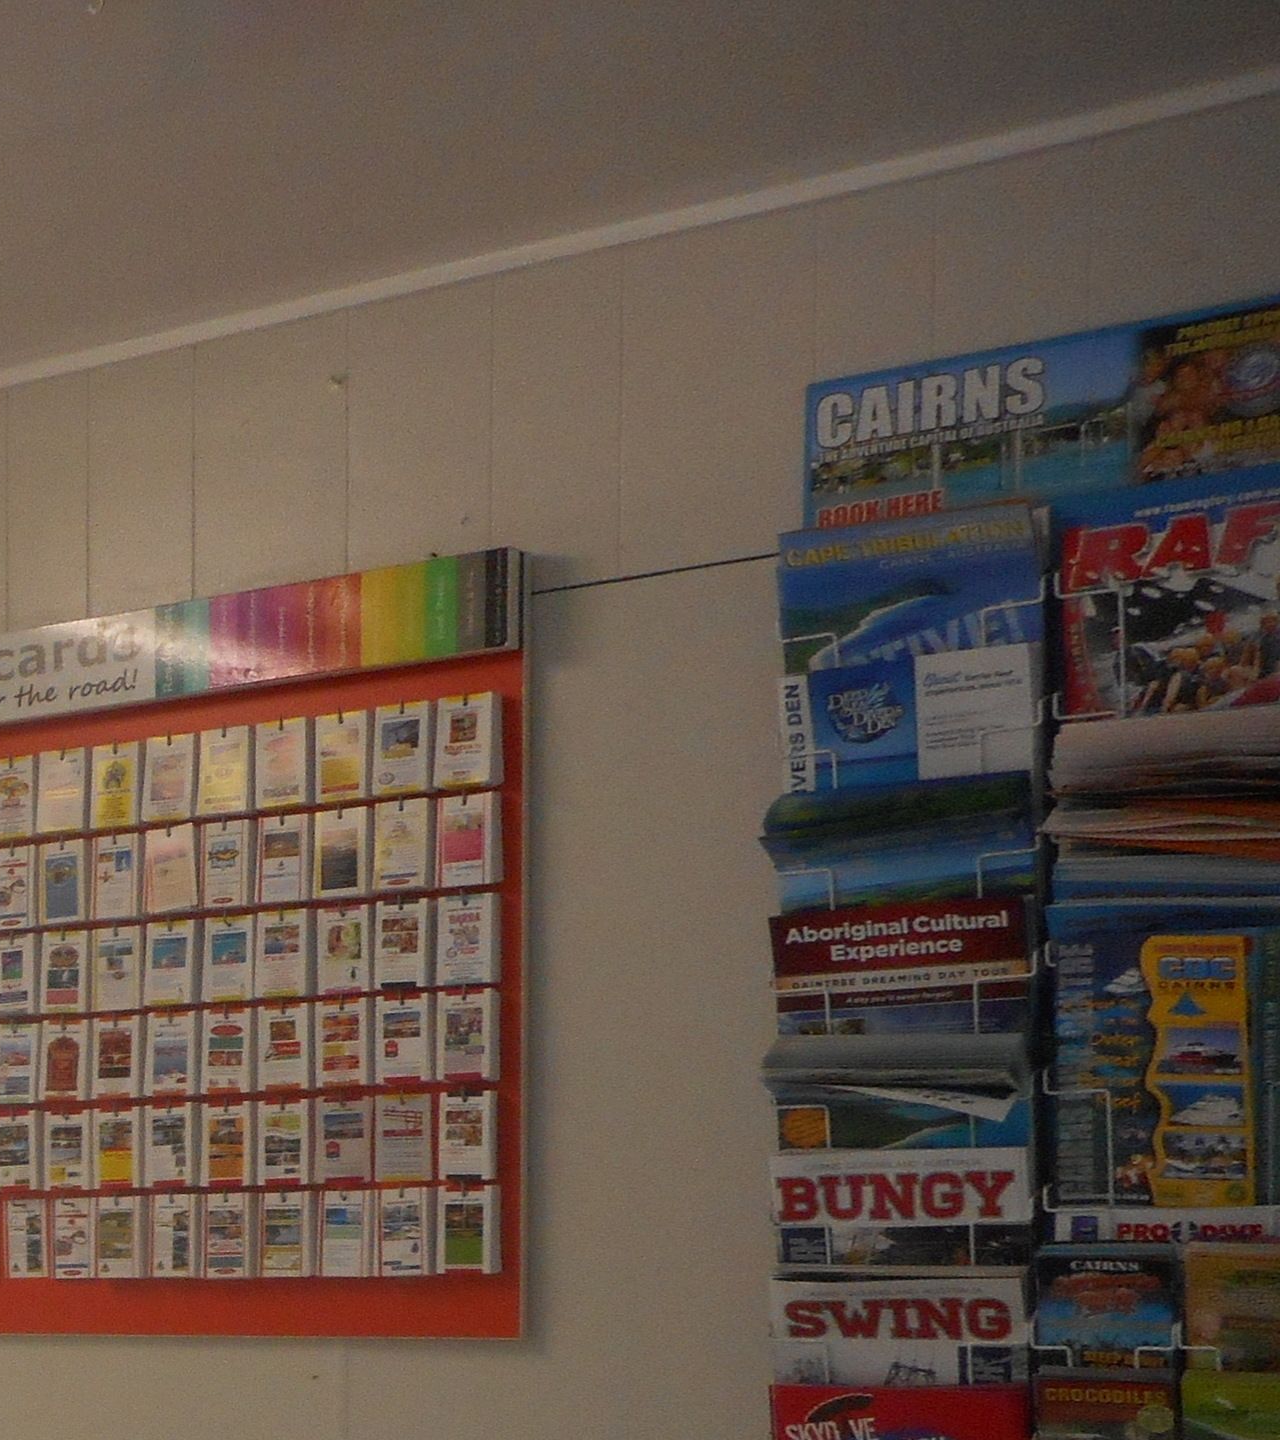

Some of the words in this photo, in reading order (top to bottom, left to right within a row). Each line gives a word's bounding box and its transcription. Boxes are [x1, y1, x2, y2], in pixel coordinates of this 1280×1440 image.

[816, 356, 1046, 450] CAIRNS
[818, 498, 880, 529] BOOK
[886, 488, 944, 518] HERE
[13, 681, 58, 710] the
[68, 669, 140, 701] road!
[785, 683, 802, 727] DEN
[784, 918, 910, 945] Aboriginal
[912, 909, 1010, 934] Cultural
[829, 937, 964, 962] Experience
[862, 972, 931, 986] DREAMING
[937, 969, 967, 980] DAY
[776, 1170, 1015, 1221] BUNGY
[1069, 1259, 1140, 1273] CAIRNS
[784, 1298, 1013, 1340] SWING
